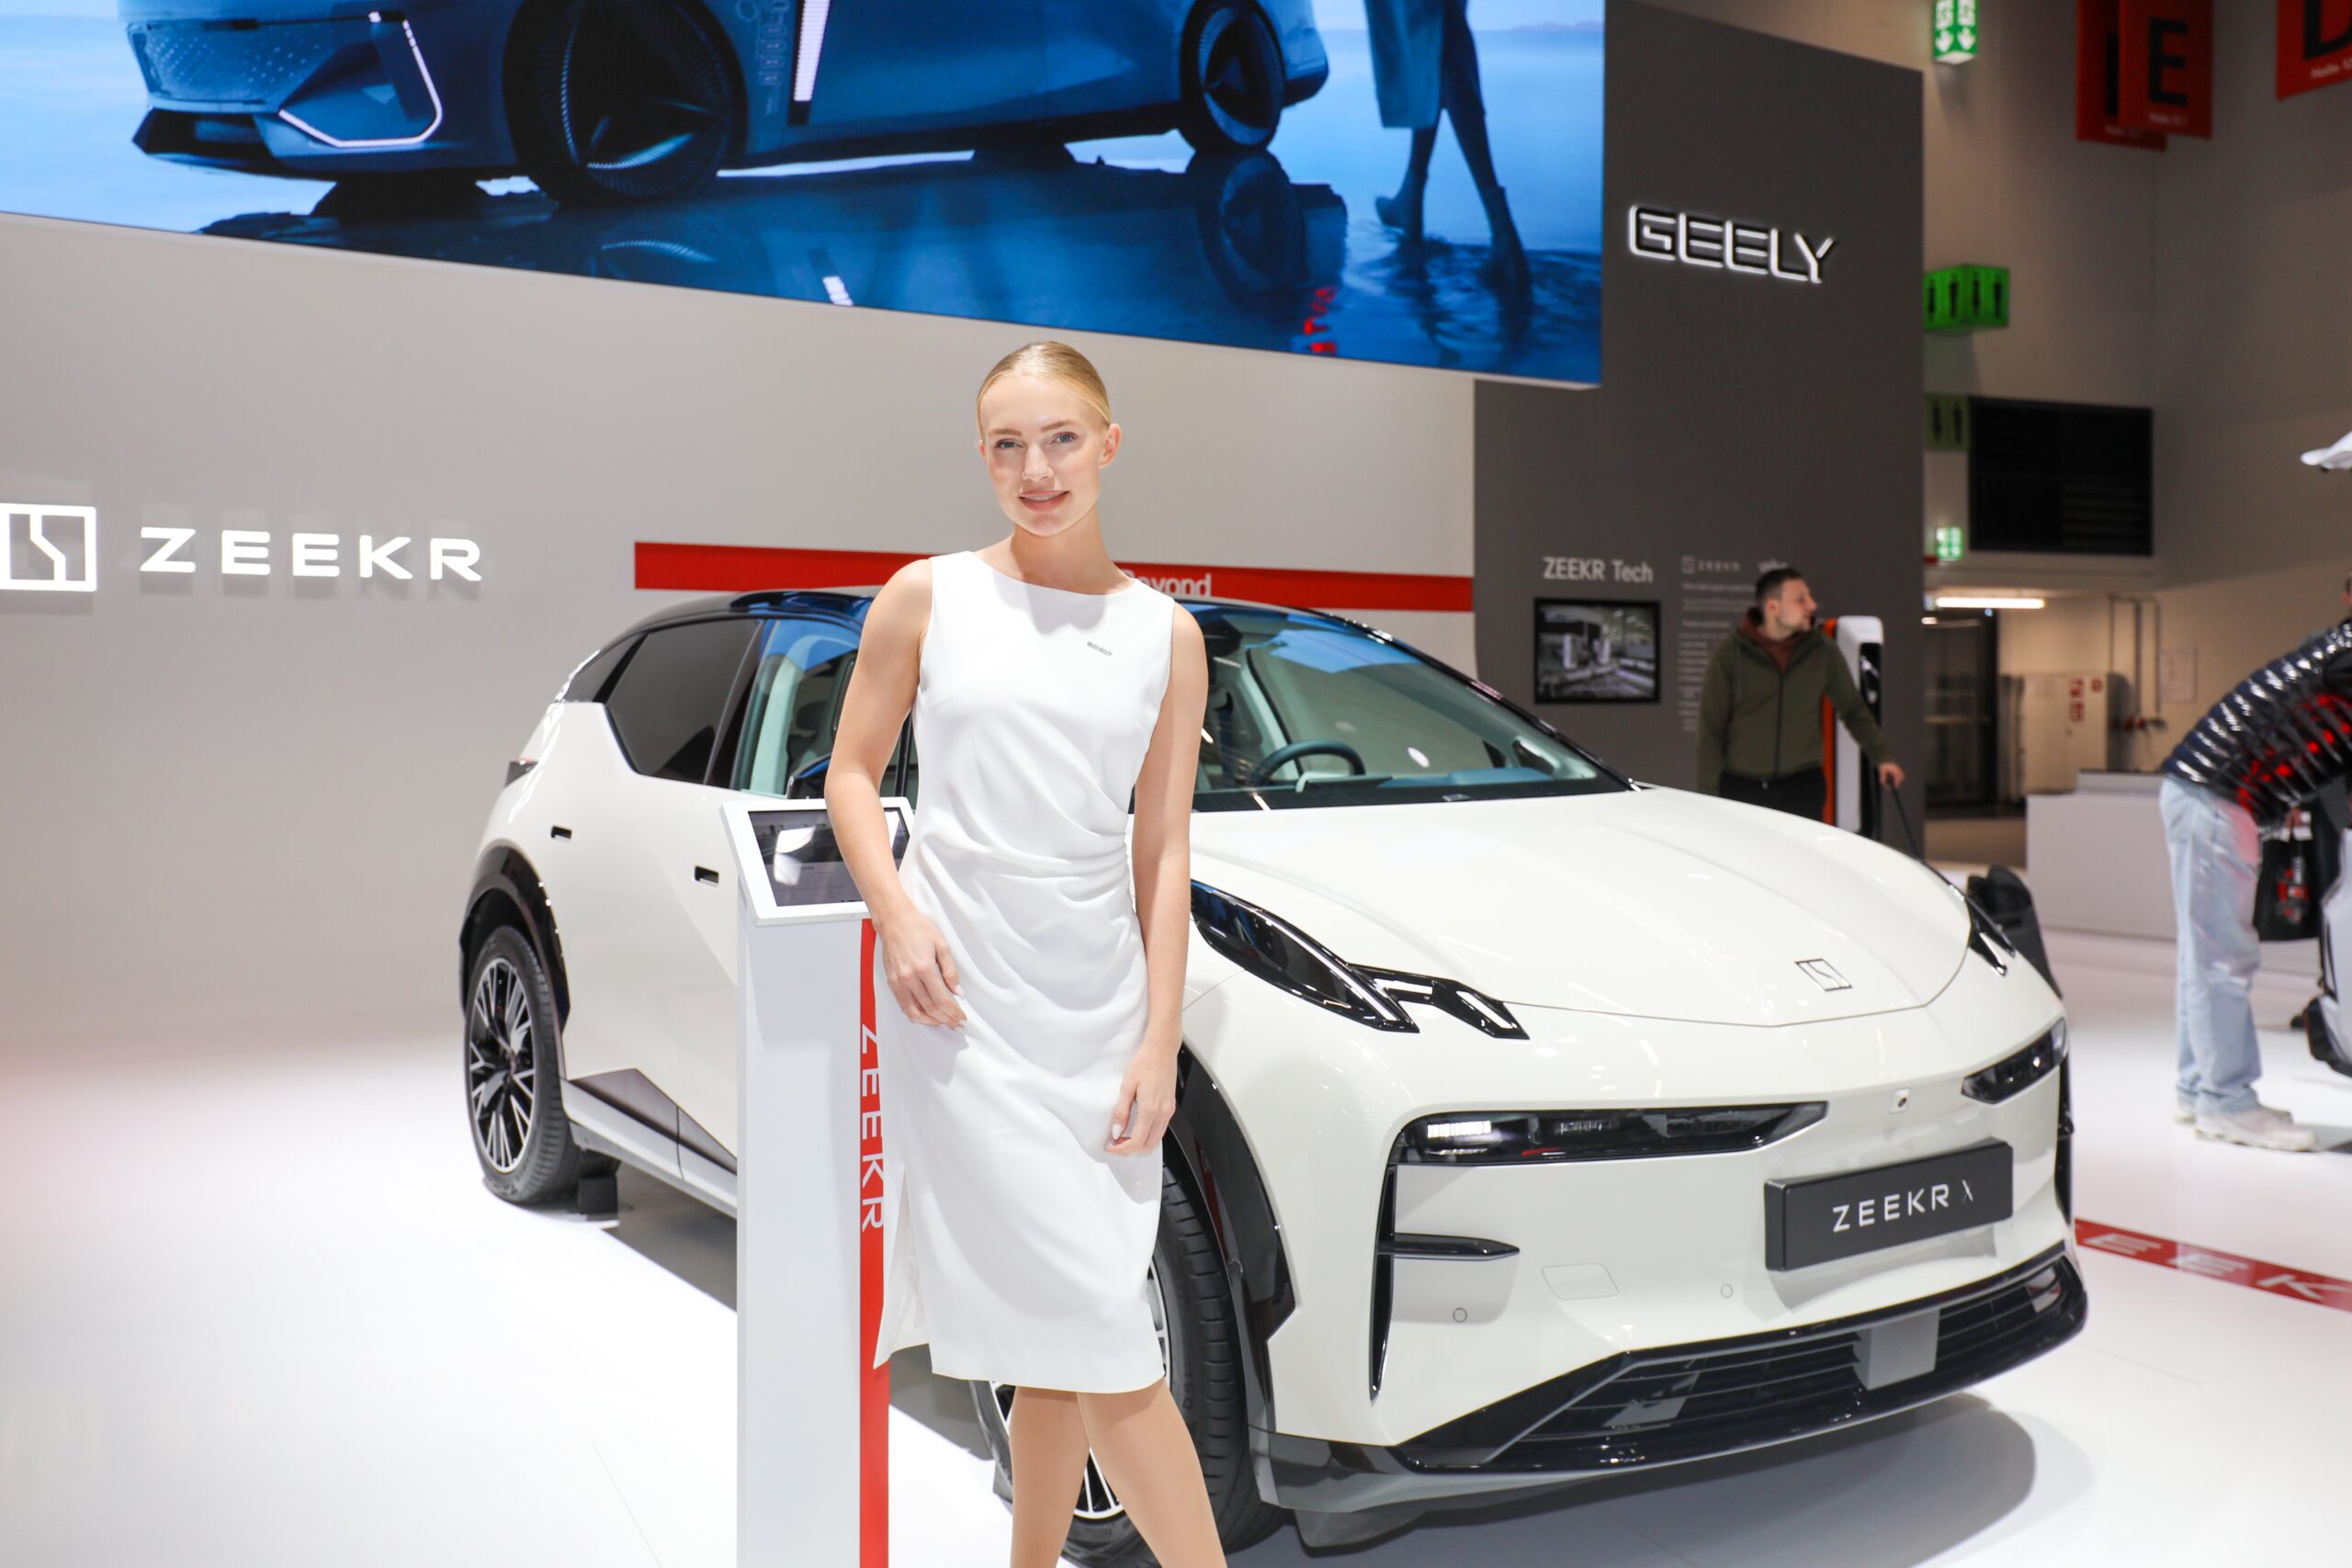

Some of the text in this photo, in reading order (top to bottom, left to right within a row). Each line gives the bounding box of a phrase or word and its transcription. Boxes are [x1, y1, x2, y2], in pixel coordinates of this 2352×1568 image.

[2148, 17, 2188, 107] E
[1629, 205, 1834, 284] GEELY
[140, 526, 482, 581] ZEEKR
[1544, 557, 1654, 583] ZEEKR Tech
[1833, 1184, 1950, 1233] ZEEKR
